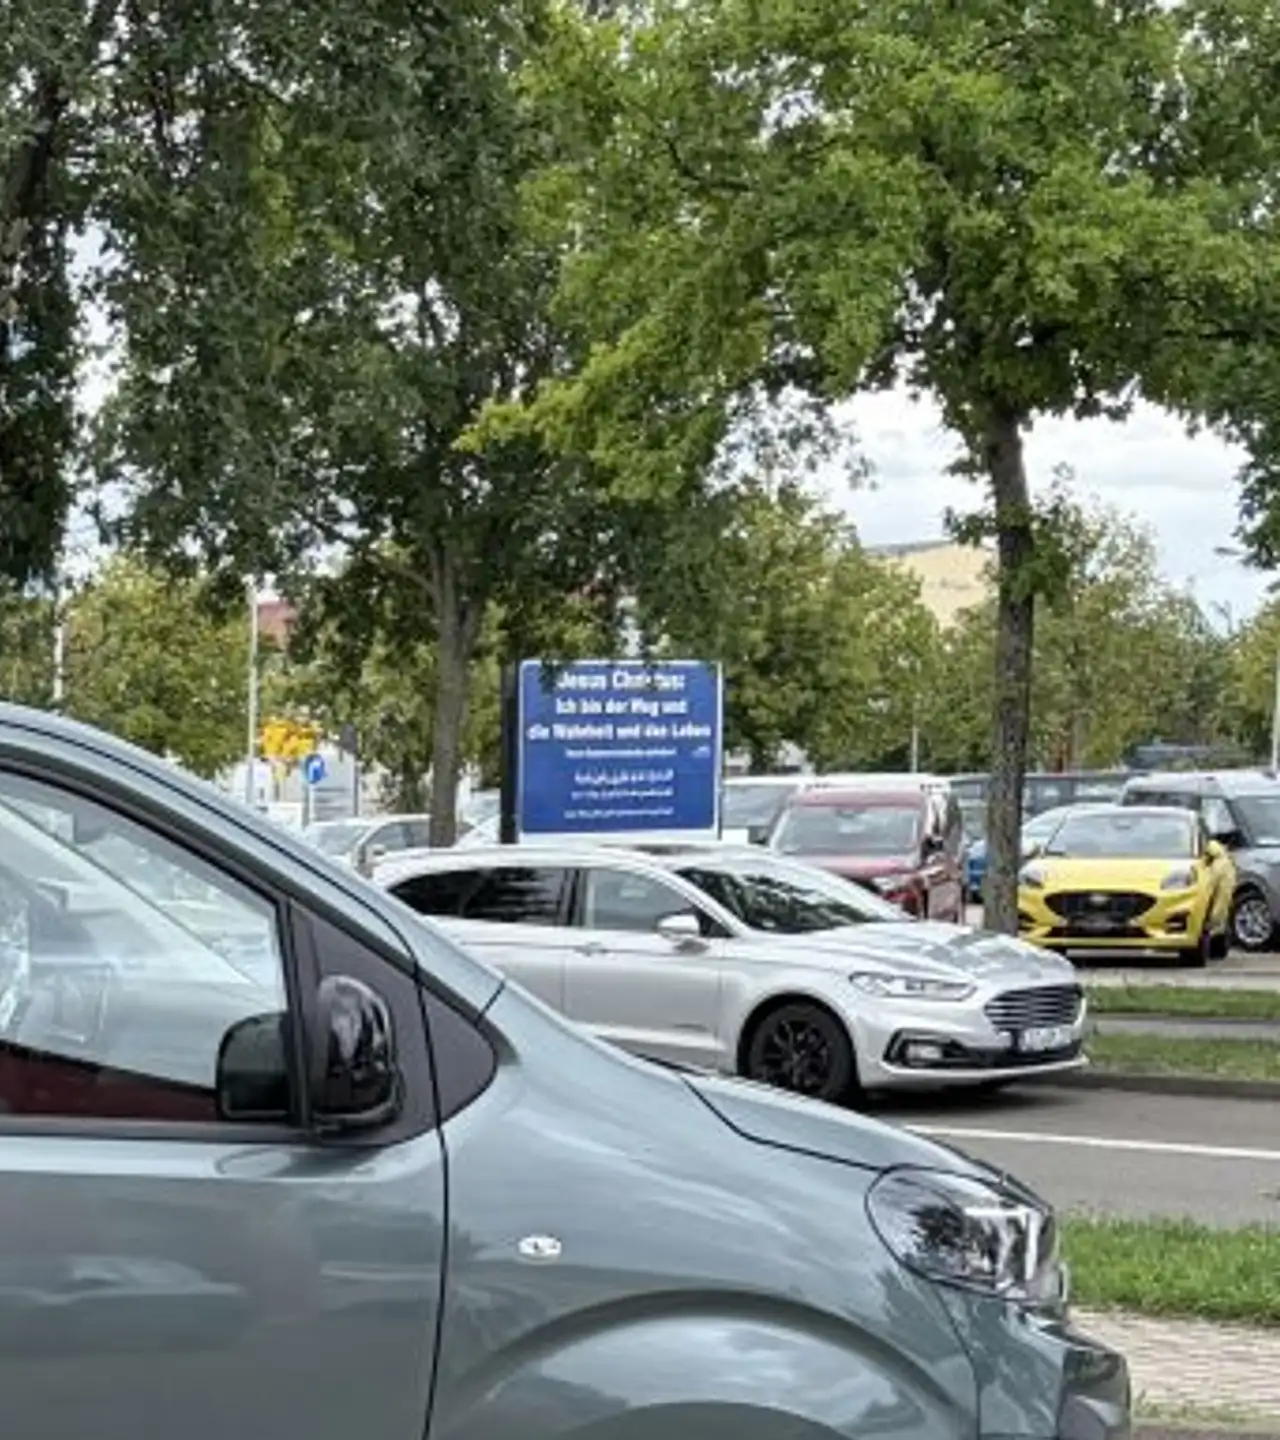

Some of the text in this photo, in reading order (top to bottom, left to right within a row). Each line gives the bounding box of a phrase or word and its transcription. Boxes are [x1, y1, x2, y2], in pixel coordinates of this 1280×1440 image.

[557, 671, 607, 691] Jesus
[556, 698, 687, 717] Ich bin der Weg und
[527, 722, 550, 740] die
[552, 722, 614, 740] Wahrheit
[616, 723, 640, 739] und
[671, 722, 712, 739] Leben
